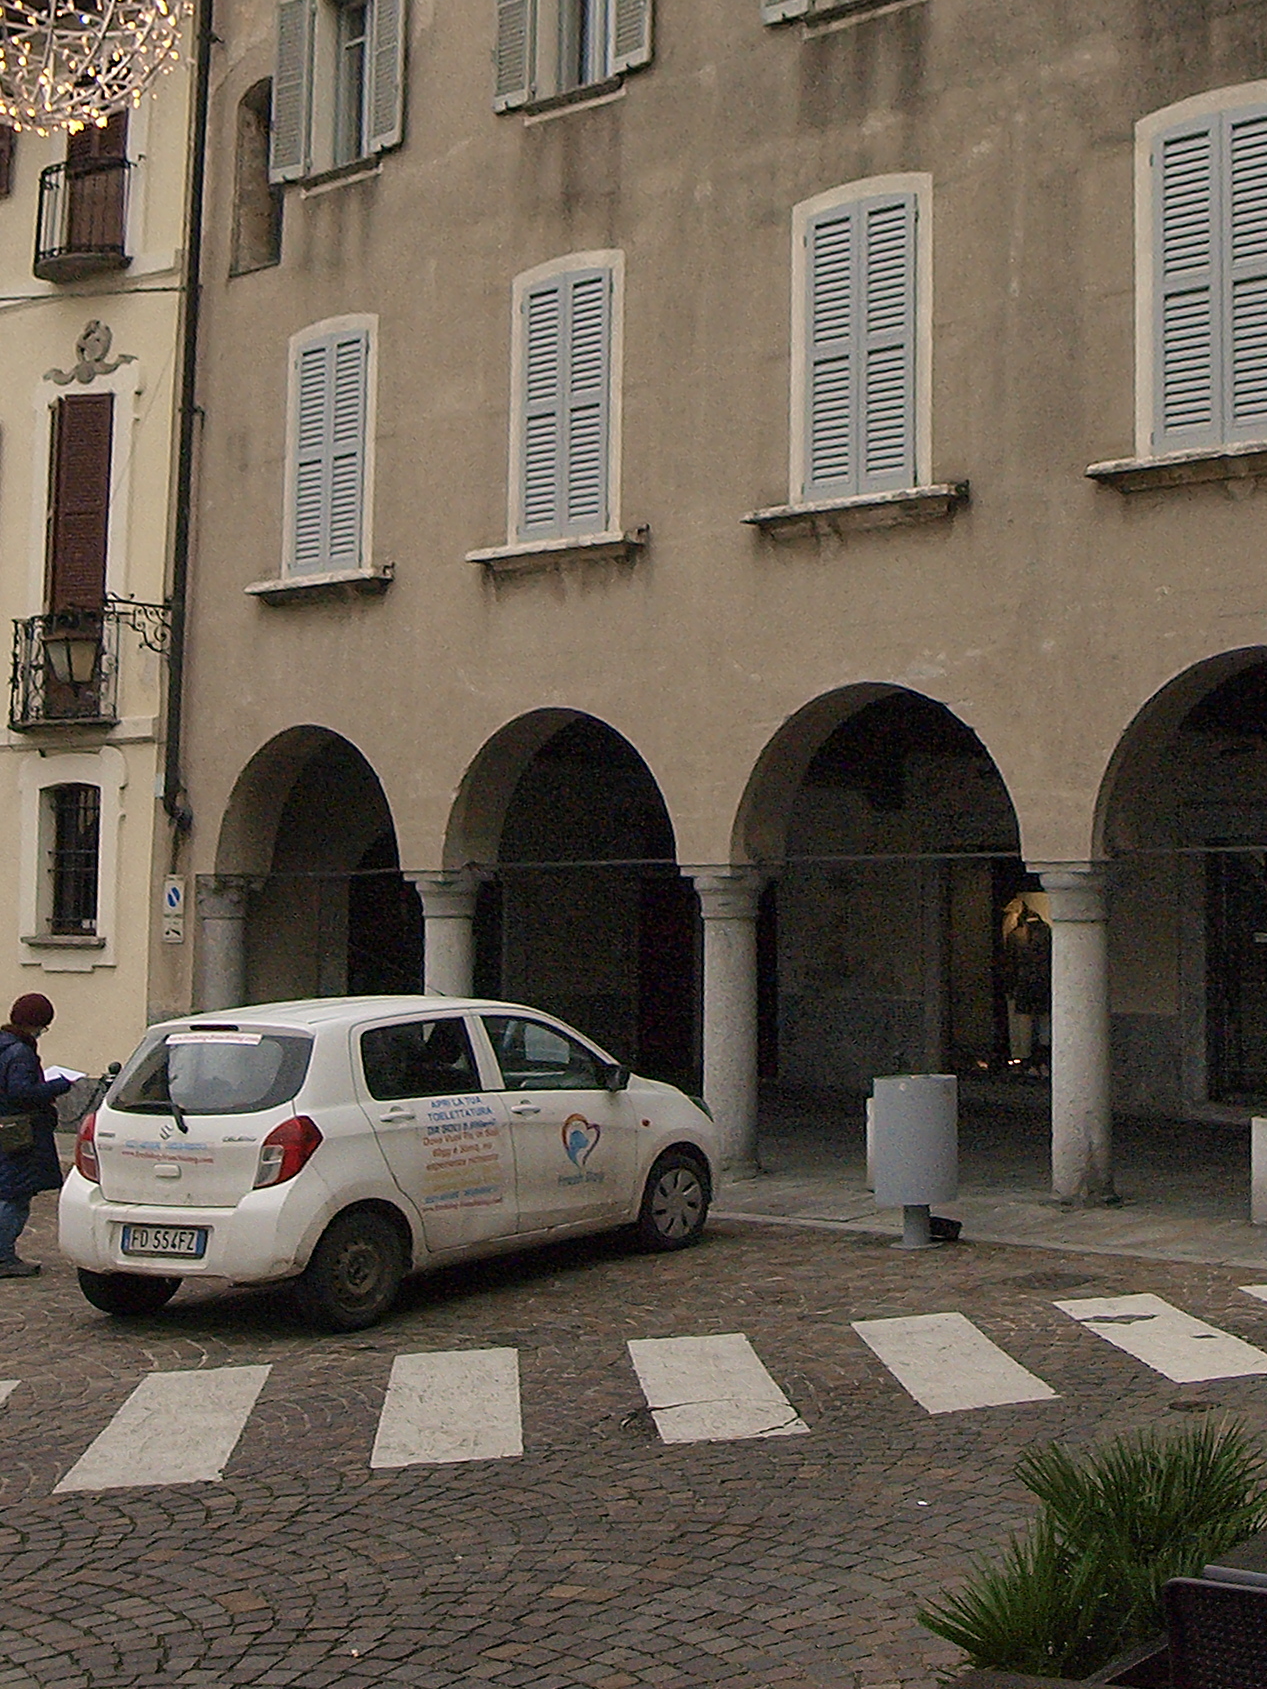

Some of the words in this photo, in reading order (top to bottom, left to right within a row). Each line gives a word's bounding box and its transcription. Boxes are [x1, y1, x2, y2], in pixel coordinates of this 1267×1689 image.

[452, 1097, 464, 1106] LA
[465, 1096, 482, 1105] TUA
[132, 1229, 148, 1248] FD
[152, 1230, 195, 1251] 554FZ
